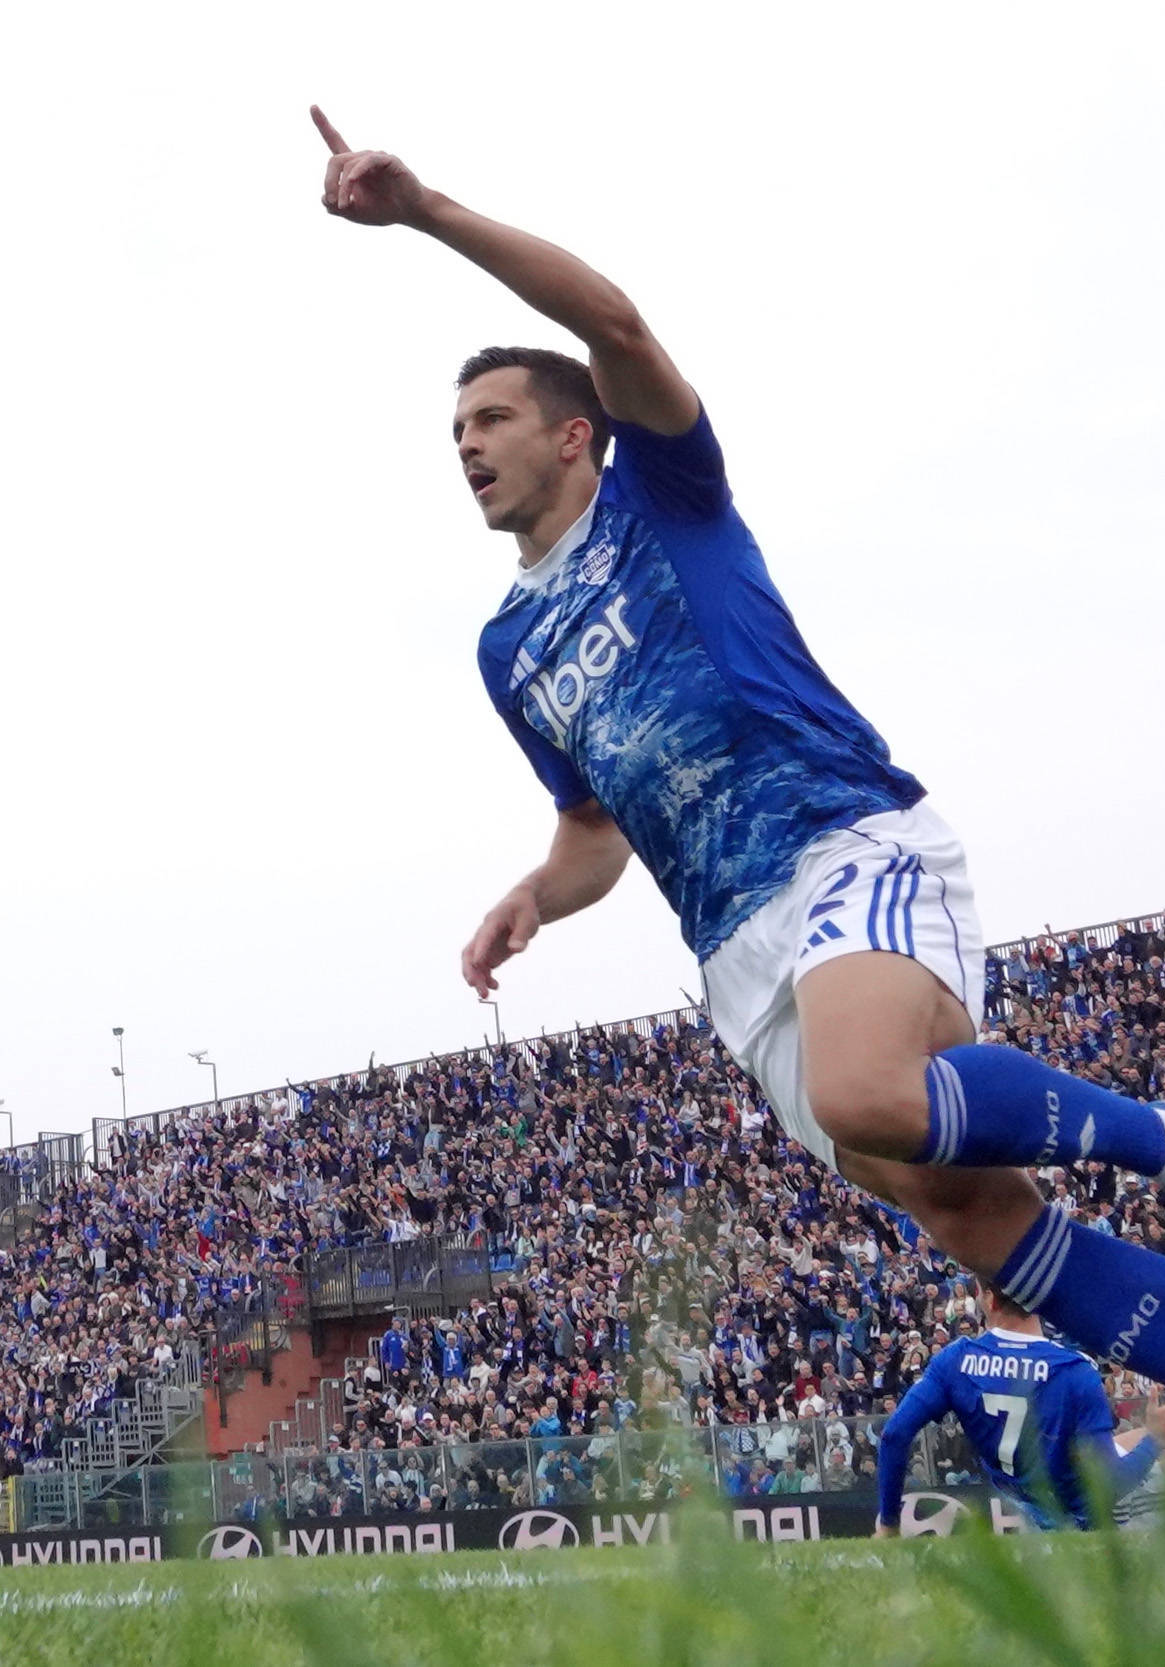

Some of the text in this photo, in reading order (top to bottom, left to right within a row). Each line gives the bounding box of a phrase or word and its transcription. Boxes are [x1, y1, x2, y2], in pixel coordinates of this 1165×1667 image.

[808, 862, 859, 922] 2
[1034, 1089, 1060, 1165] OMO
[960, 1354, 1049, 1382] MORATA
[981, 1392, 1028, 1477] 7
